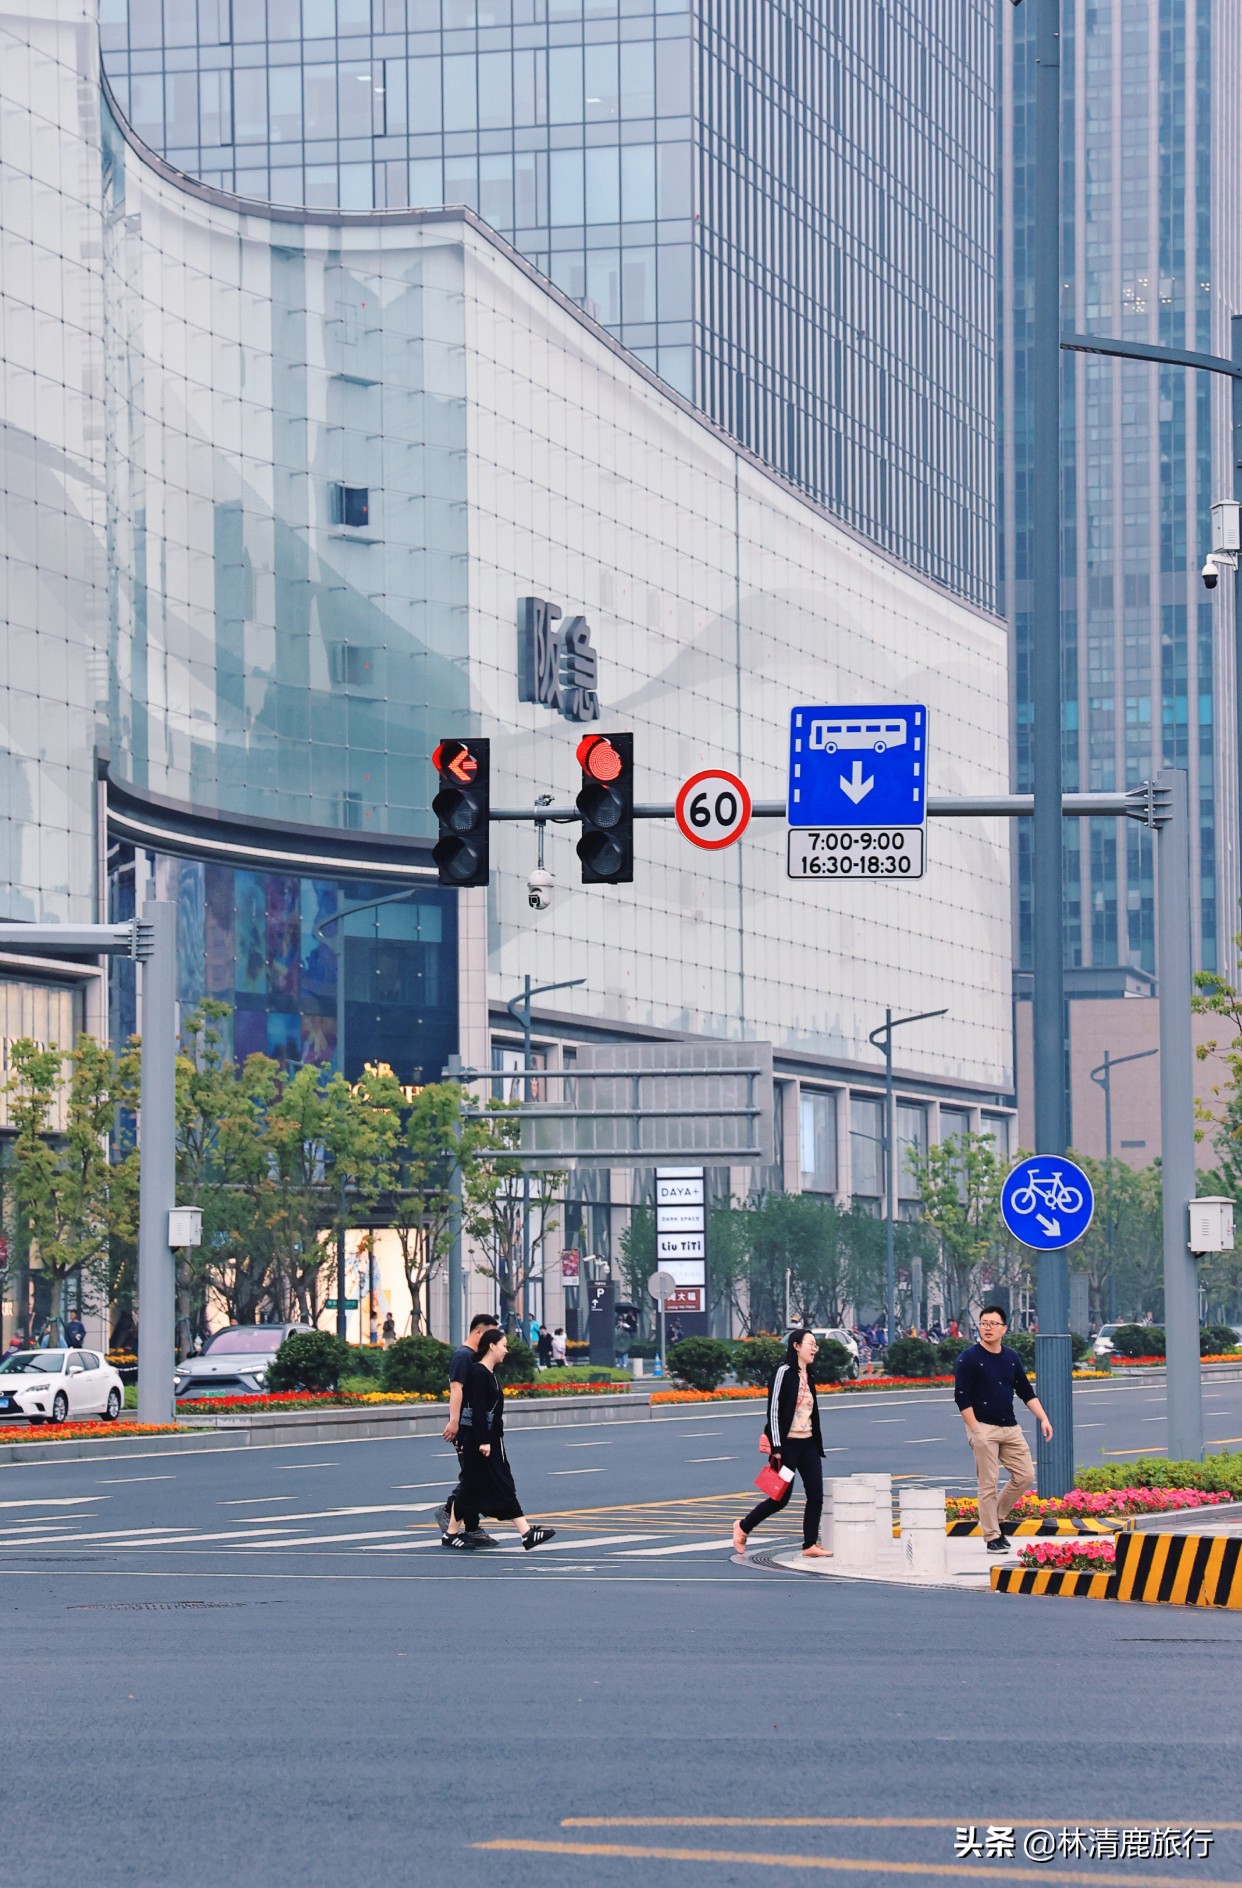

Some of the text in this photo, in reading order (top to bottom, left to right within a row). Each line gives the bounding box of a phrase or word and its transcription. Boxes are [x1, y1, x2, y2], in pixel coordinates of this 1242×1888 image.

[517, 597, 601, 723] 阪急
[690, 792, 737, 827] 60
[808, 832, 905, 851] 7:00-9:00
[801, 855, 911, 874] 16:30-18:30
[661, 1187, 700, 1197] DAYA+
[661, 1240, 701, 1251] Liu TiTi
[596, 1287, 605, 1298] P
